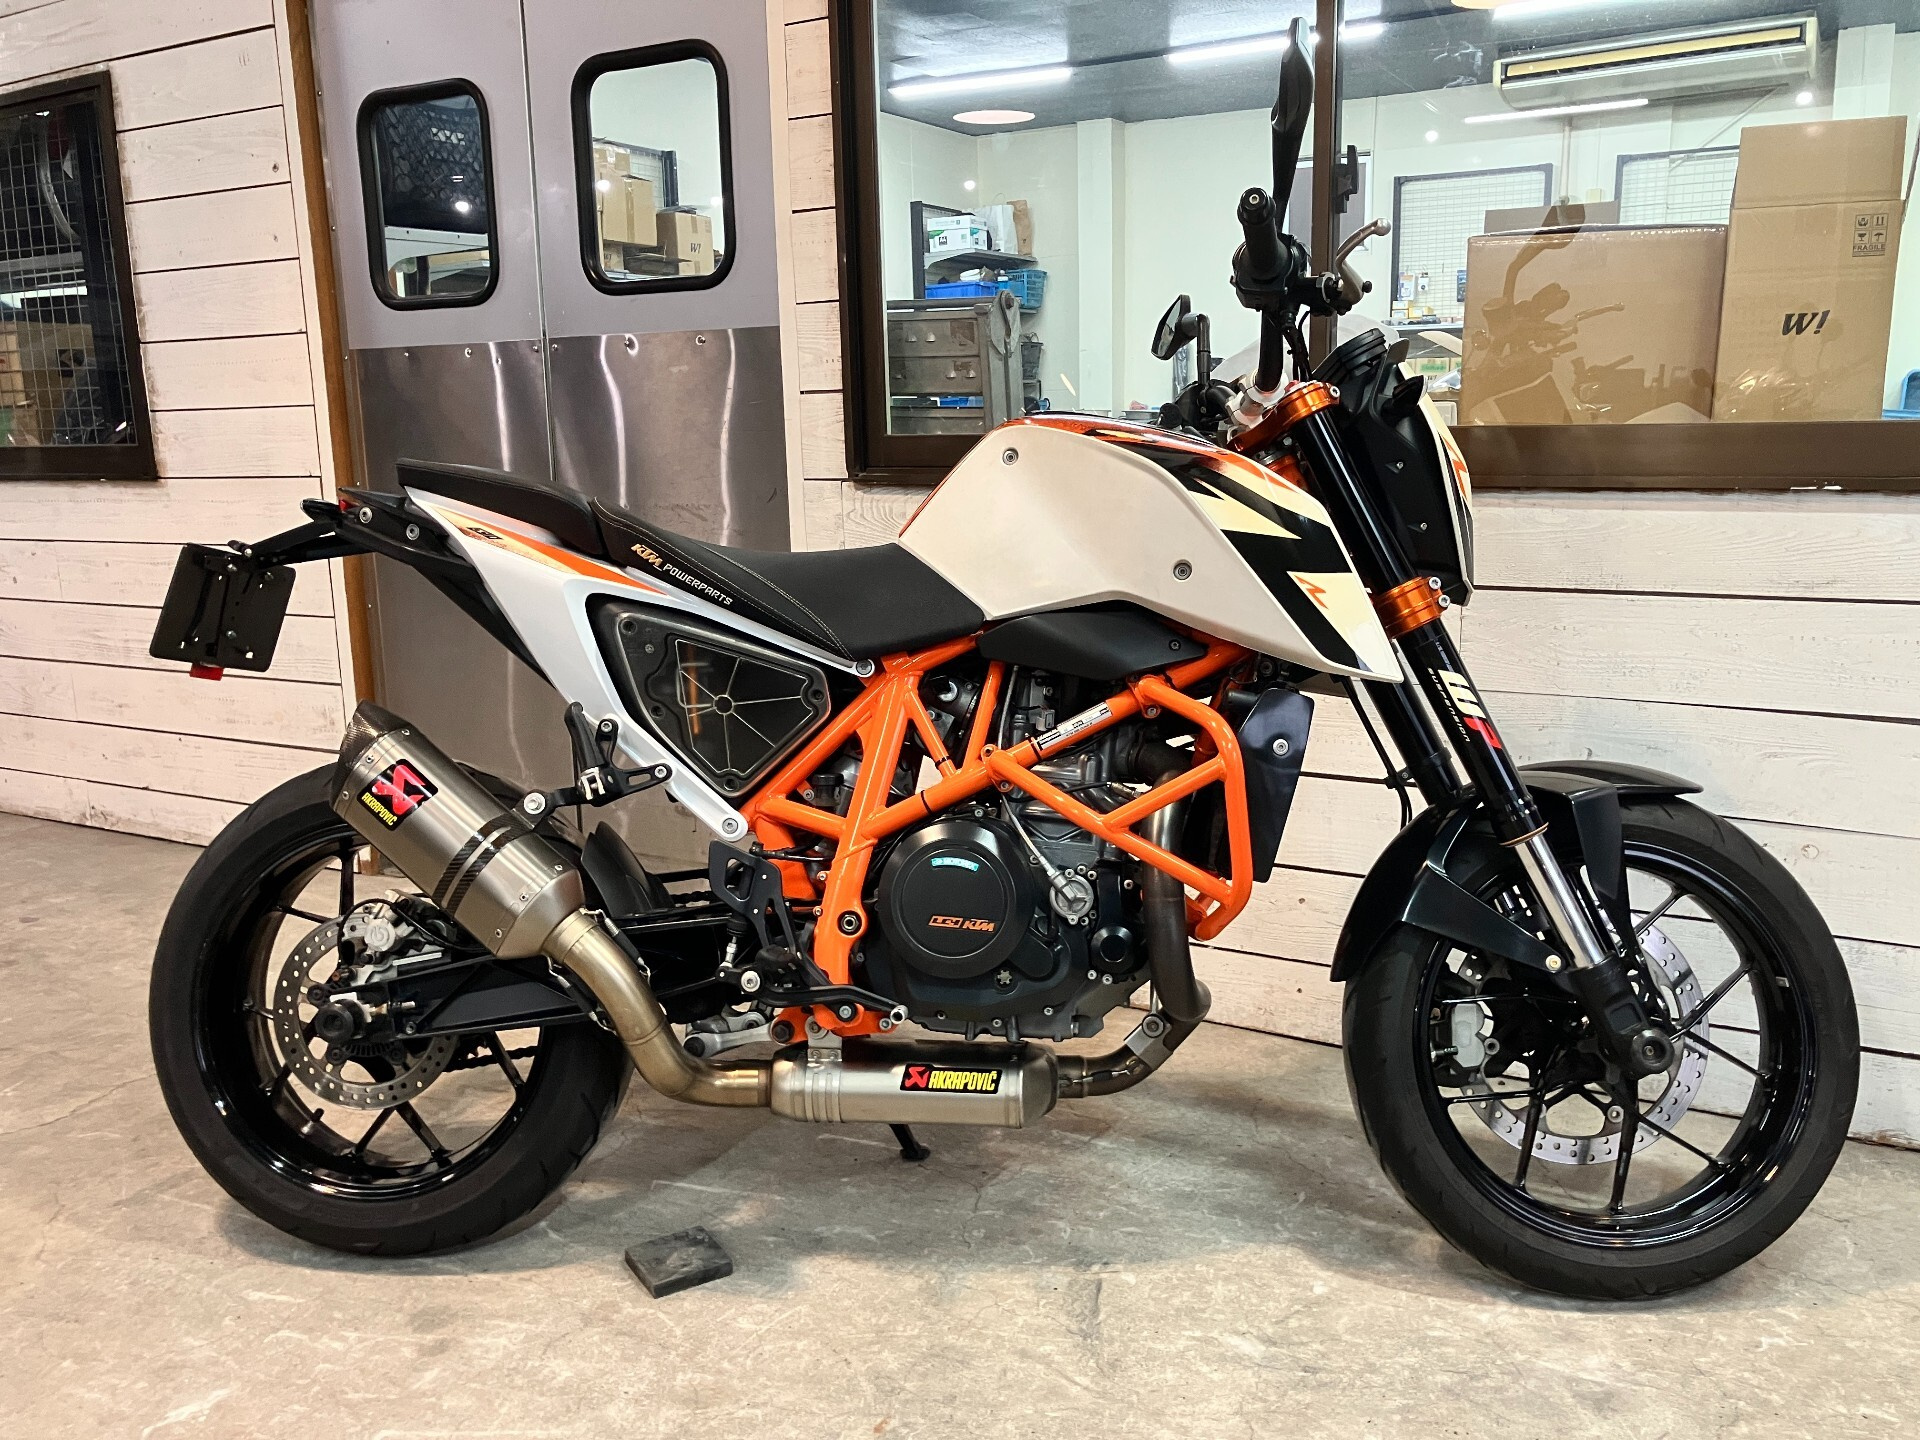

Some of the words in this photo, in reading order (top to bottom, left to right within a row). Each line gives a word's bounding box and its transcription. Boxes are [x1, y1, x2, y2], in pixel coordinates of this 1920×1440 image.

[1853, 243, 1886, 251] FRAGILE
[1781, 309, 1831, 336] W!
[630, 543, 664, 567] KTM
[662, 563, 734, 606] POWERPARTS
[962, 918, 996, 932] KTM
